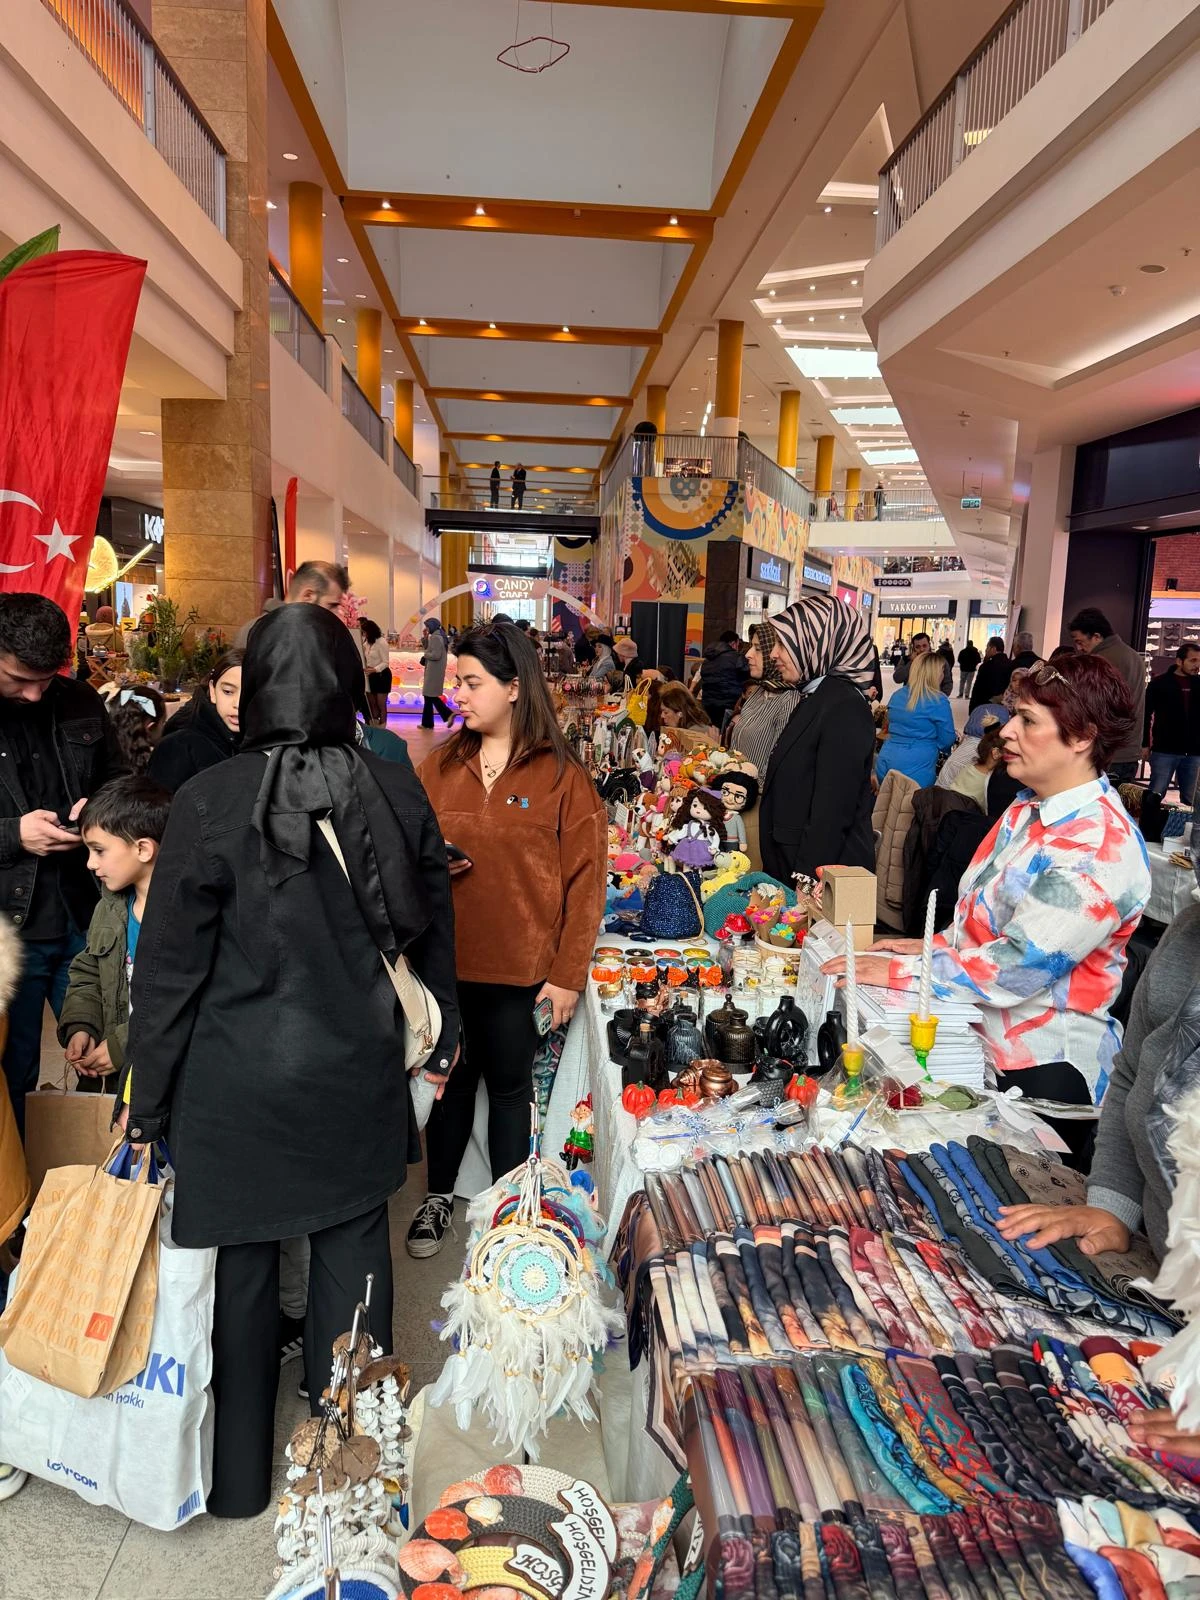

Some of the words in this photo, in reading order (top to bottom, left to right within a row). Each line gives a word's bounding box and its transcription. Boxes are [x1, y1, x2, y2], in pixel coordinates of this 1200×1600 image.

[494, 578, 535, 591] CANDY
[499, 590, 529, 599] CRAFT
[890, 603, 917, 612] VAKKO
